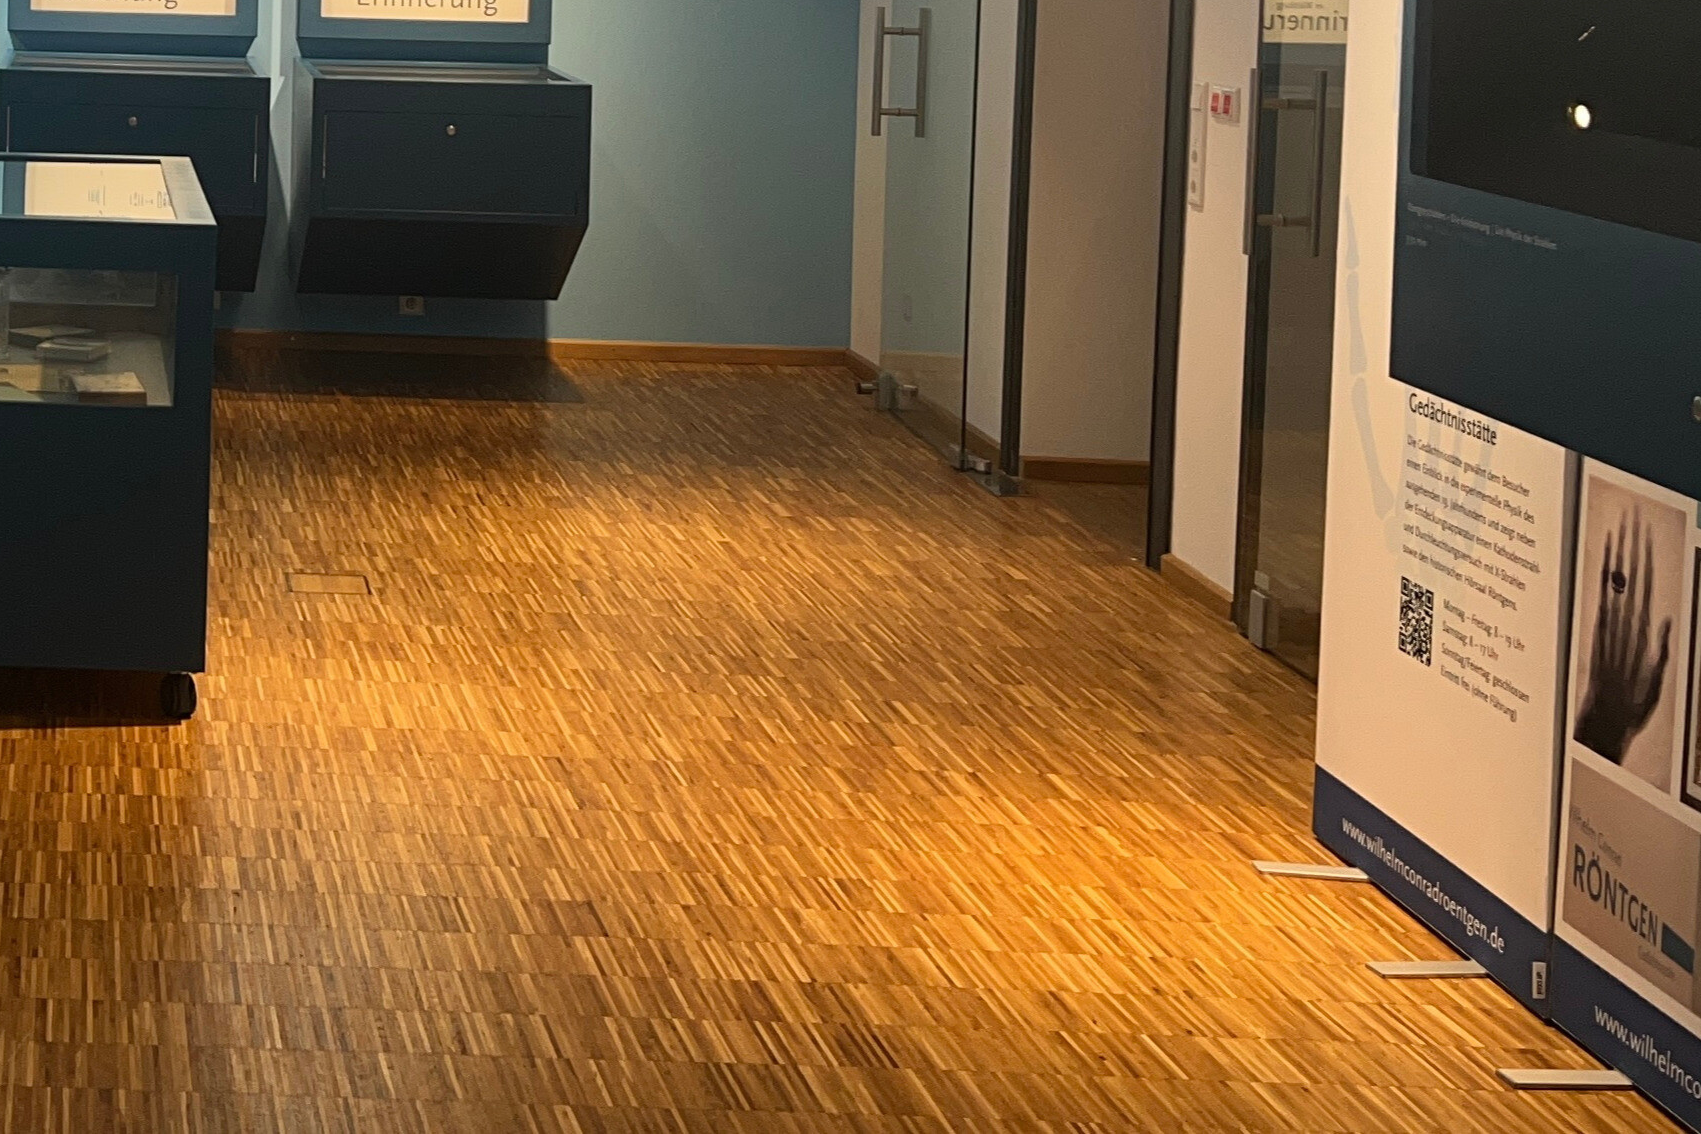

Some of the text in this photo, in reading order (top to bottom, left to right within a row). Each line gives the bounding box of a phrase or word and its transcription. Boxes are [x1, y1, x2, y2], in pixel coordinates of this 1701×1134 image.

[1409, 392, 1497, 446] Gedächtnisstätte
[1487, 646, 1499, 661] Uhr
[1513, 637, 1525, 652] Uhr
[1342, 817, 1505, 954] www.wilhelmconradroentgen.de
[1573, 843, 1658, 947] RÖNTGEN
